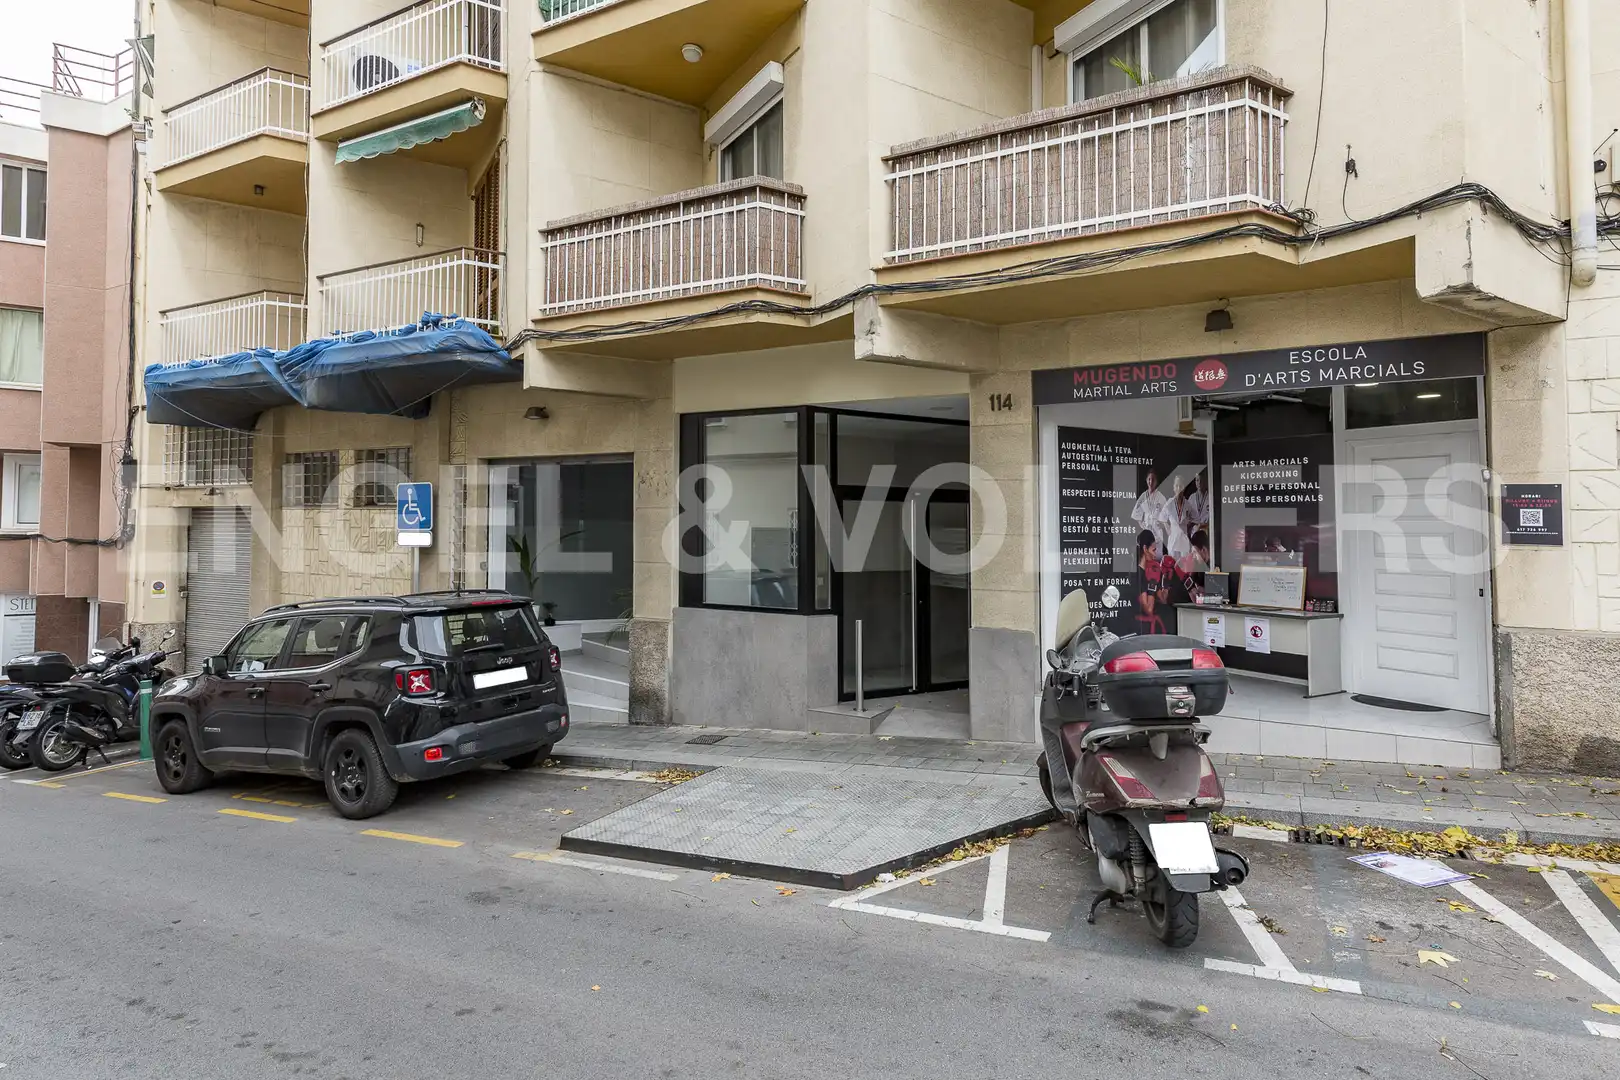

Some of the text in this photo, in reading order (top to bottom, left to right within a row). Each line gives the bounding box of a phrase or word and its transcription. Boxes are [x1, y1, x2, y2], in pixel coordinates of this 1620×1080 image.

[1289, 346, 1367, 365] ESCOLA
[1073, 363, 1177, 386] MUGENDO
[1244, 361, 1425, 388] D'ARTS MARCIALS
[1073, 381, 1178, 399] MARTIAL ARTS
[989, 393, 1013, 411] 114
[1061, 442, 1132, 454] AUGMENTA LA TEVA
[1061, 452, 1108, 463] AUTOESTIMA
[1115, 456, 1154, 466] SEGURETAT
[1232, 456, 1309, 468] ARTS MARCIALS
[1061, 462, 1100, 472] PERSONAL
[1240, 470, 1299, 480] KICKBOXING
[1224, 481, 1320, 492] DEFENSA PERSONAL
[1062, 488, 1096, 498] RESPECTE
[1101, 490, 1137, 499] DISCIPLINA
[1221, 494, 1324, 504] CLASSES PERSONALS
[1062, 515, 1120, 524] EINES PER A LA
[1062, 524, 1089, 534] GESTIÓ
[1063, 547, 1130, 555] AUGMENT LA TEVA
[1063, 557, 1112, 566] FLEXIBILITAT
[1094, 578, 1104, 586] EN
[1106, 578, 1130, 586] FORMA
